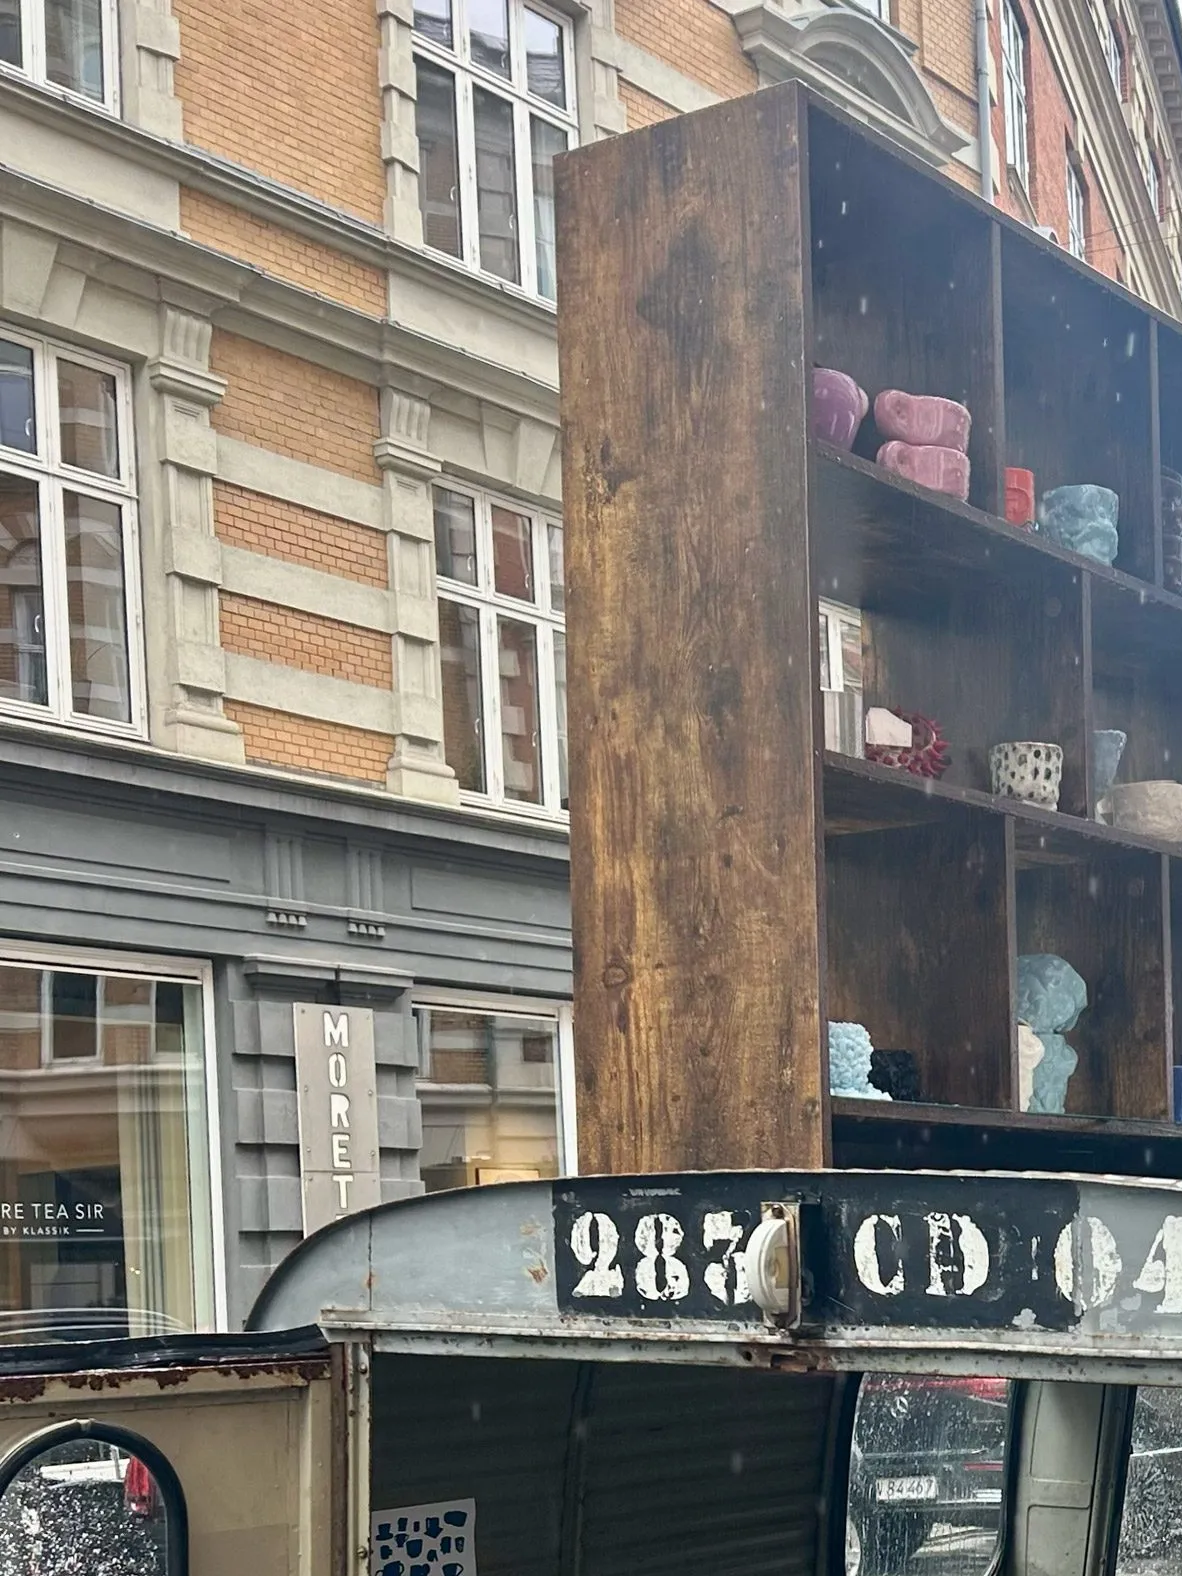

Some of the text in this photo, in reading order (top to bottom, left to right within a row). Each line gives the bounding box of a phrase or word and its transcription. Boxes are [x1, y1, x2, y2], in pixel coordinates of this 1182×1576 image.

[322, 1010, 354, 1221] MORET
[3, 1226, 70, 1236] BY KLASSIK
[31, 1203, 69, 1220] TEA
[75, 1203, 104, 1220] SIR
[853, 1211, 990, 1298] CD
